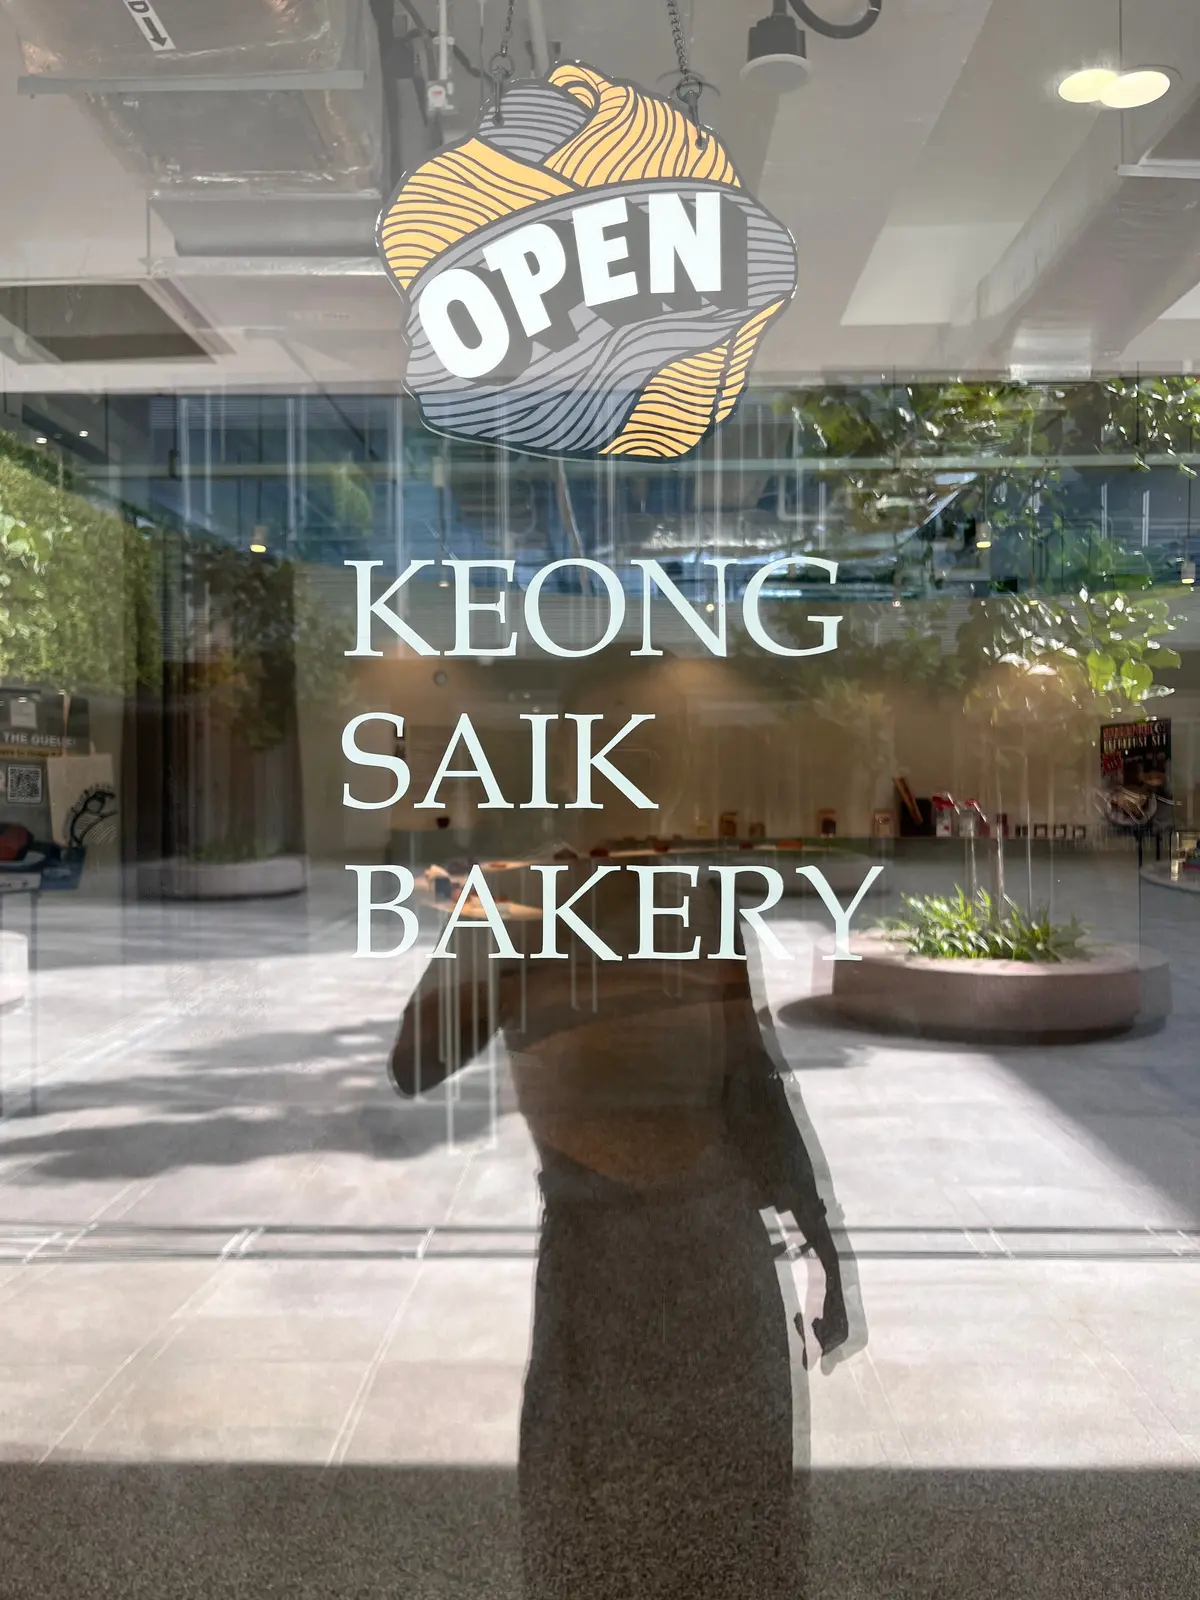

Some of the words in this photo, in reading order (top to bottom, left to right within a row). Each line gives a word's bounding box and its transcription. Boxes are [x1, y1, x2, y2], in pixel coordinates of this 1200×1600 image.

[418, 191, 722, 379] OPEN
[343, 556, 843, 658] KEONG
[4, 732, 28, 744] THE
[341, 712, 659, 810] SAIK
[344, 864, 885, 962] BAKERY
